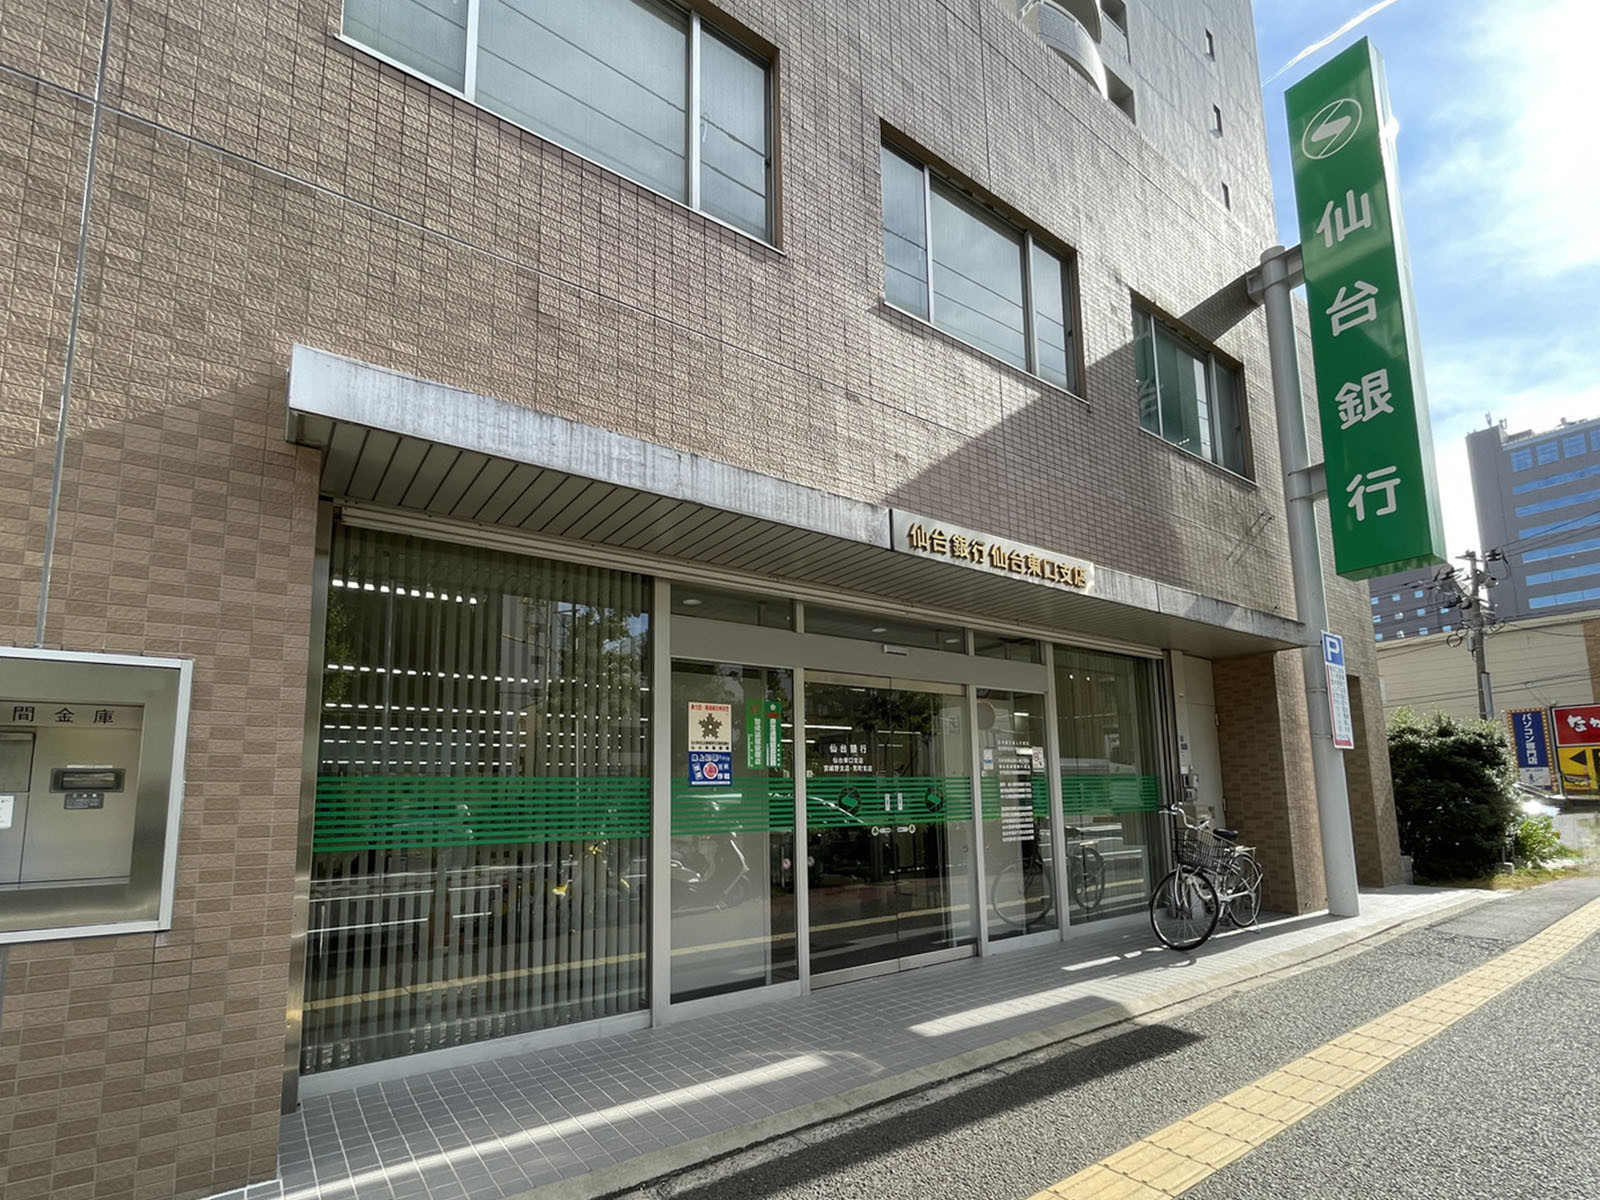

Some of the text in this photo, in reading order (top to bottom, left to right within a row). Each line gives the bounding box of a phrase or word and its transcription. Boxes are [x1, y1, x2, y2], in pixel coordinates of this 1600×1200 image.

[1315, 188, 1401, 522] 仙台銀行
[907, 522, 1088, 588] 仙台銀行 仙台東口支店
[1325, 636, 1340, 661] P
